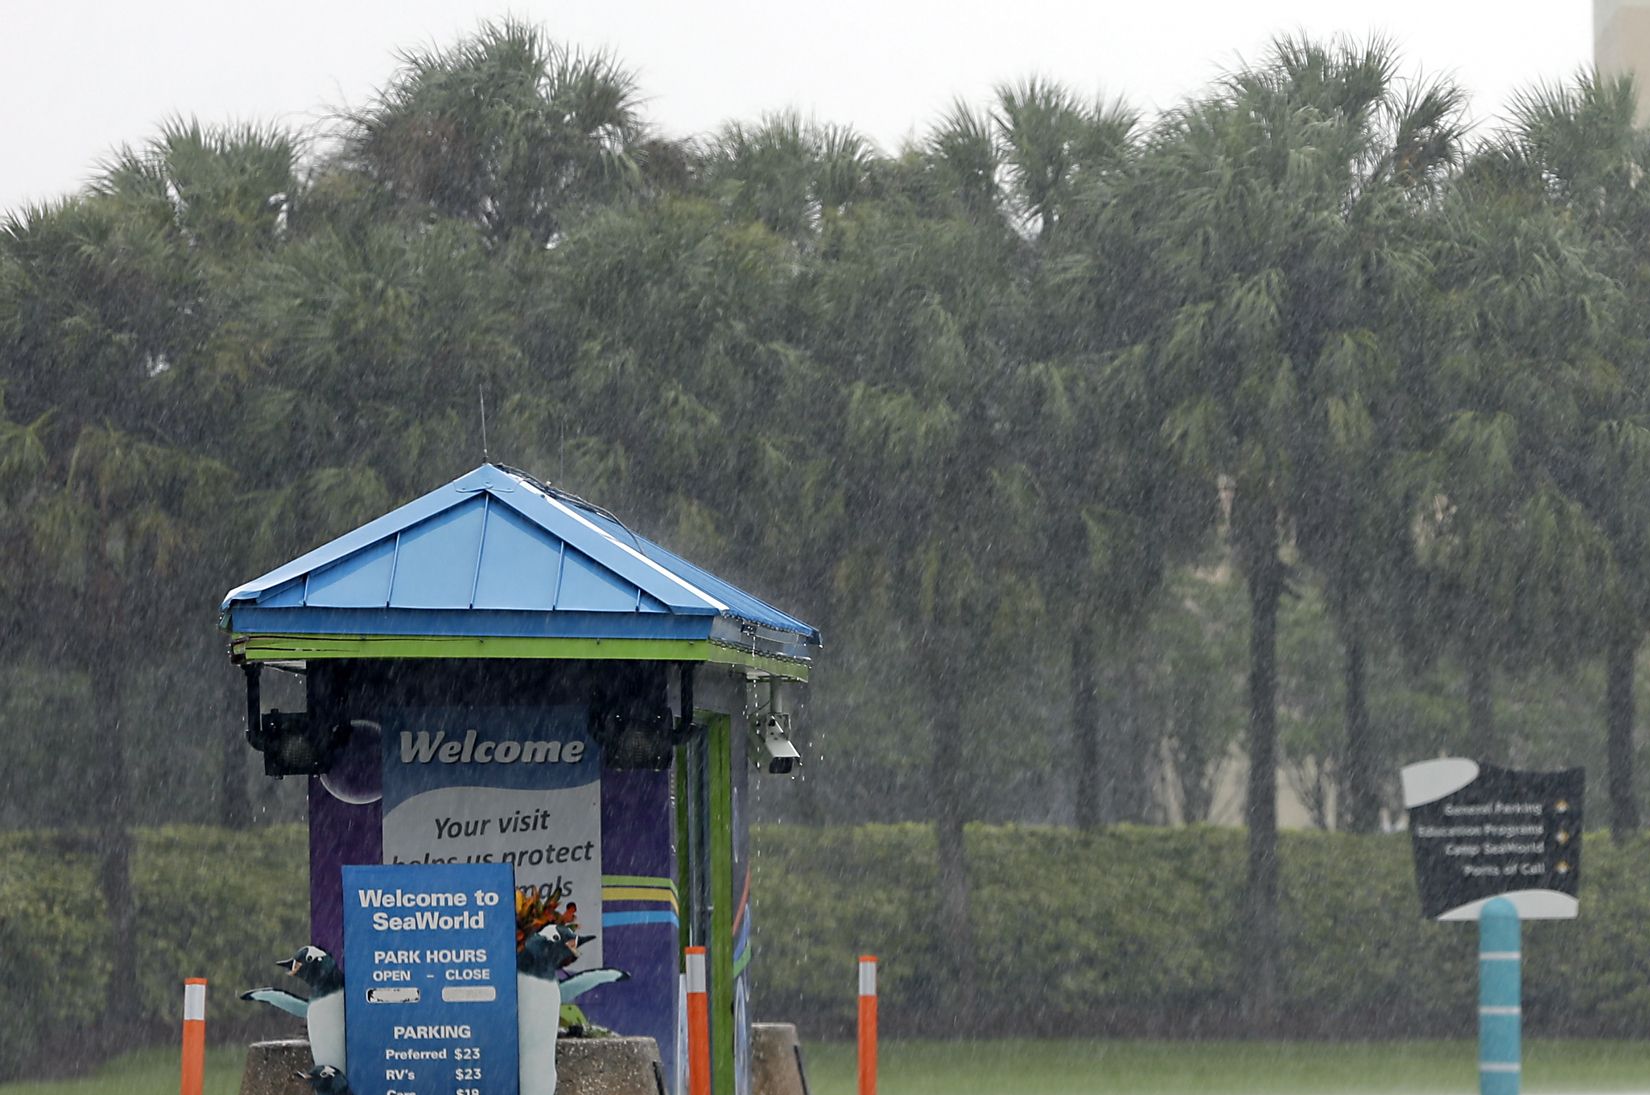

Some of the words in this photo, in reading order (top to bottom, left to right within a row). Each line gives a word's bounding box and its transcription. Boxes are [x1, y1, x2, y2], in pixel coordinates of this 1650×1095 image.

[400, 729, 586, 764] Welcome
[1444, 803, 1493, 817] General
[1494, 802, 1543, 816] Parking
[435, 817, 491, 840] Your
[499, 808, 551, 833] visit
[1417, 825, 1482, 838] Education
[1484, 824, 1545, 839] Programs
[1445, 845, 1481, 858] Camp
[1483, 841, 1545, 855] SeaWorld
[1463, 864, 1500, 877] Ports
[1503, 863, 1518, 876] of
[1521, 863, 1546, 875] Call
[358, 889, 468, 908] Welcome
[474, 889, 500, 907] to
[372, 910, 485, 931] SeaWorld
[374, 950, 421, 965] PARK
[426, 949, 487, 964] HOURS
[372, 970, 411, 982] OPEN
[445, 969, 490, 981] CLOSE
[393, 1025, 472, 1039] PARKING
[385, 1048, 447, 1060] Preferred
[454, 1047, 481, 1061] $23
[385, 1069, 416, 1080] RV's
[455, 1068, 482, 1081] $23
